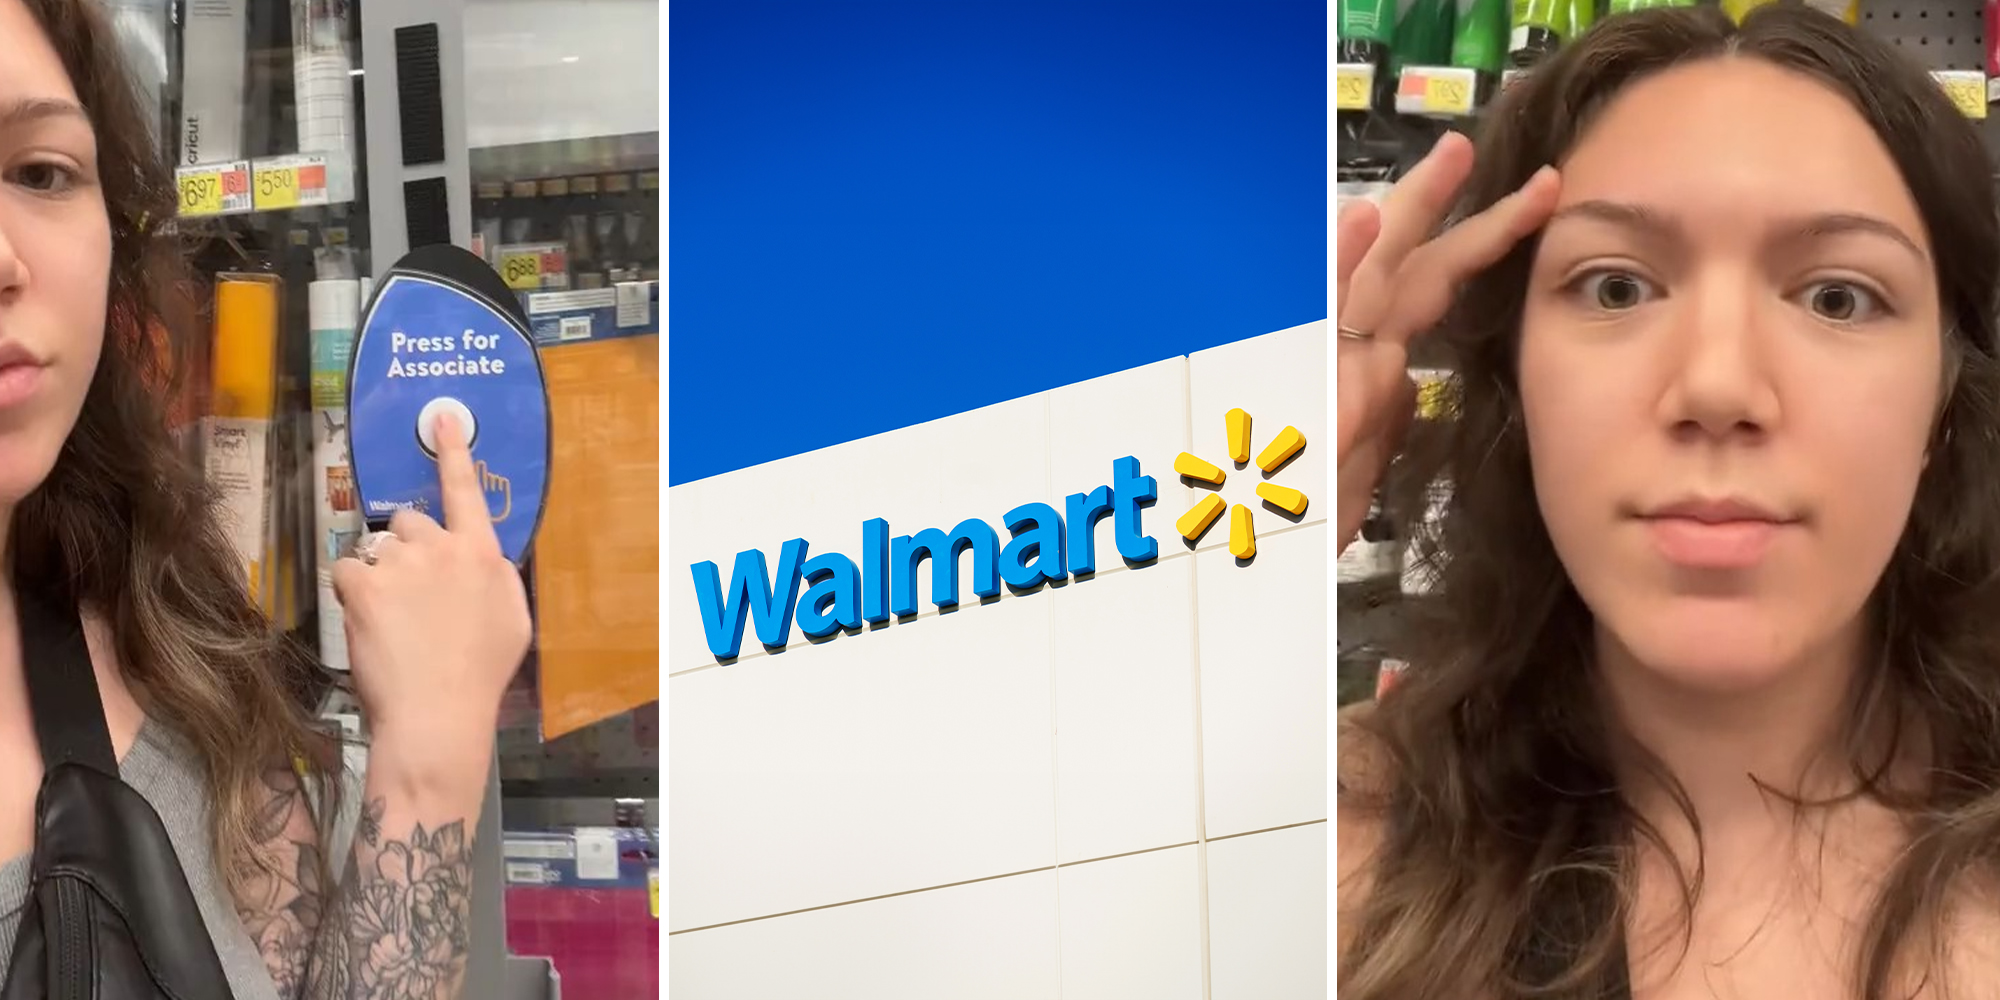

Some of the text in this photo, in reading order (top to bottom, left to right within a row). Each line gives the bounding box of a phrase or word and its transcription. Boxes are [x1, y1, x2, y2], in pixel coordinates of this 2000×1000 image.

[185, 116, 199, 165] cricut
[391, 329, 500, 353] Press for
[387, 354, 505, 378] Associate
[690, 455, 1157, 659] Walmart
